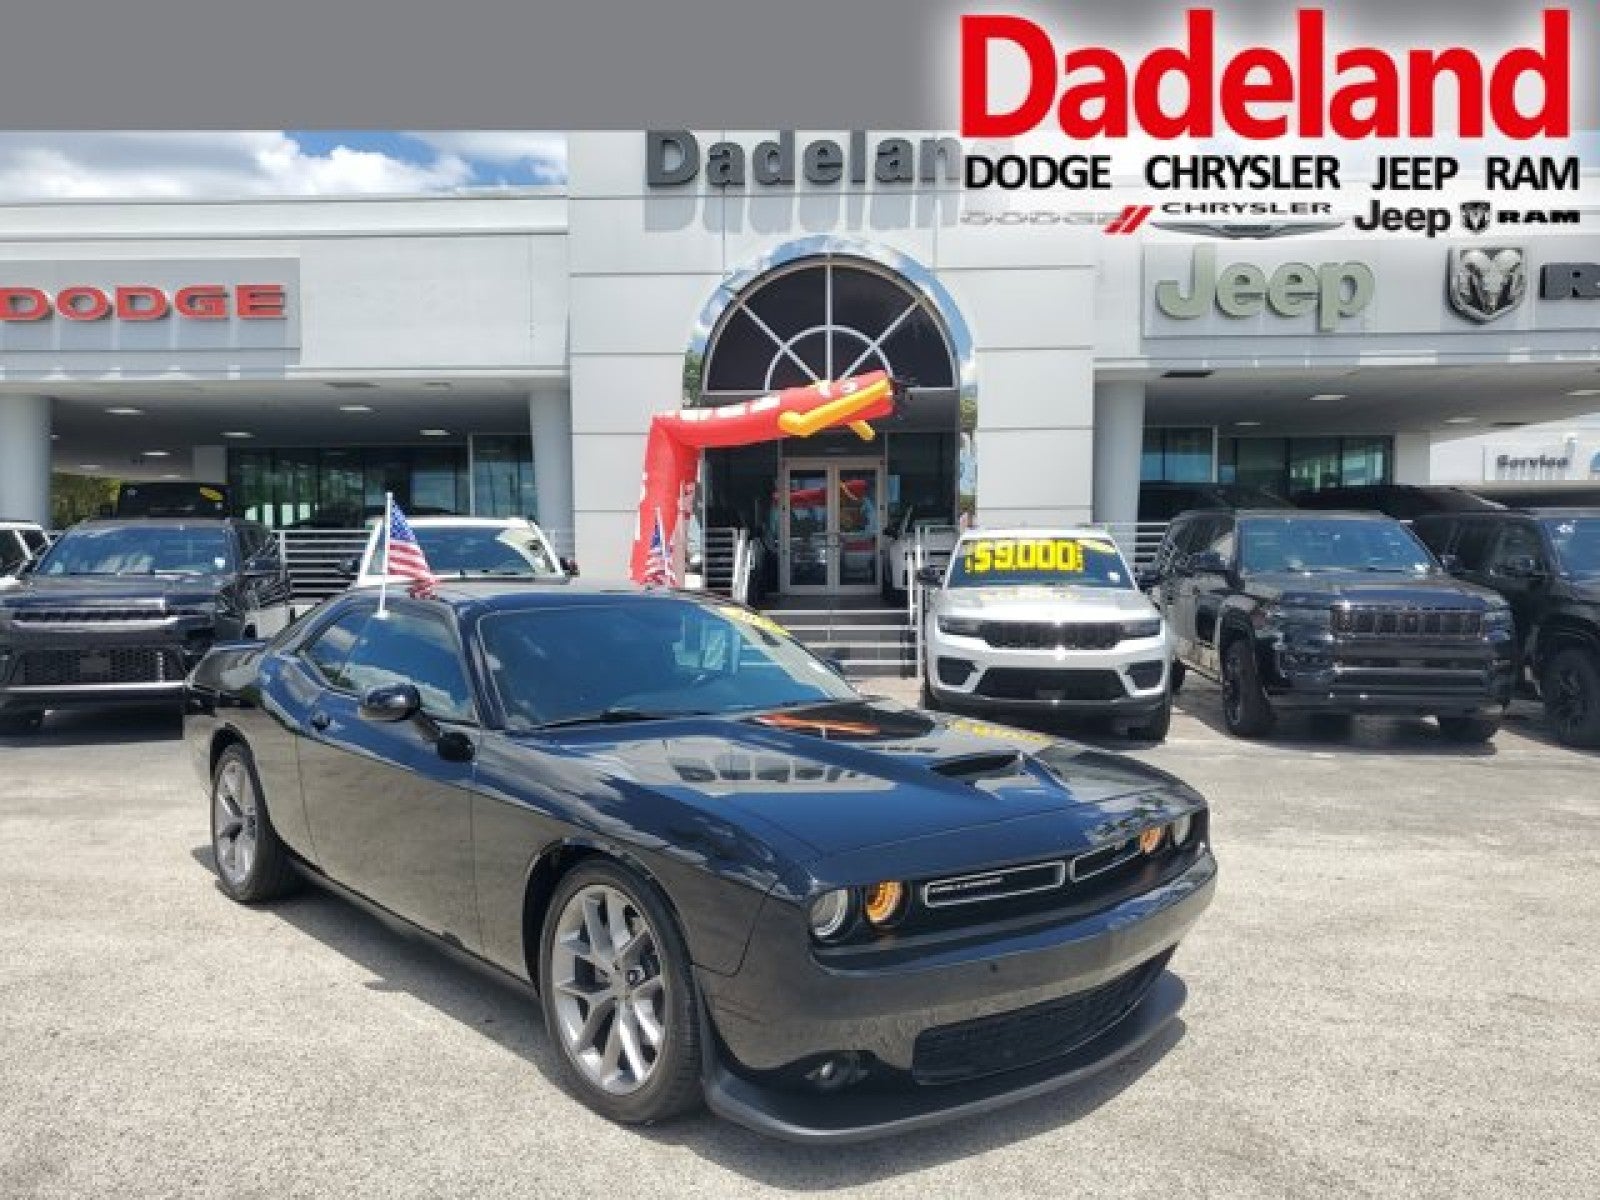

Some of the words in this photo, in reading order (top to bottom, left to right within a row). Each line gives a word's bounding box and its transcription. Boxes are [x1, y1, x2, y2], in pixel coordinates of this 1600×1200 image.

[646, 129, 963, 188] Dadelan
[0, 284, 287, 321] DODGE
[1155, 245, 1375, 332] Jeep
